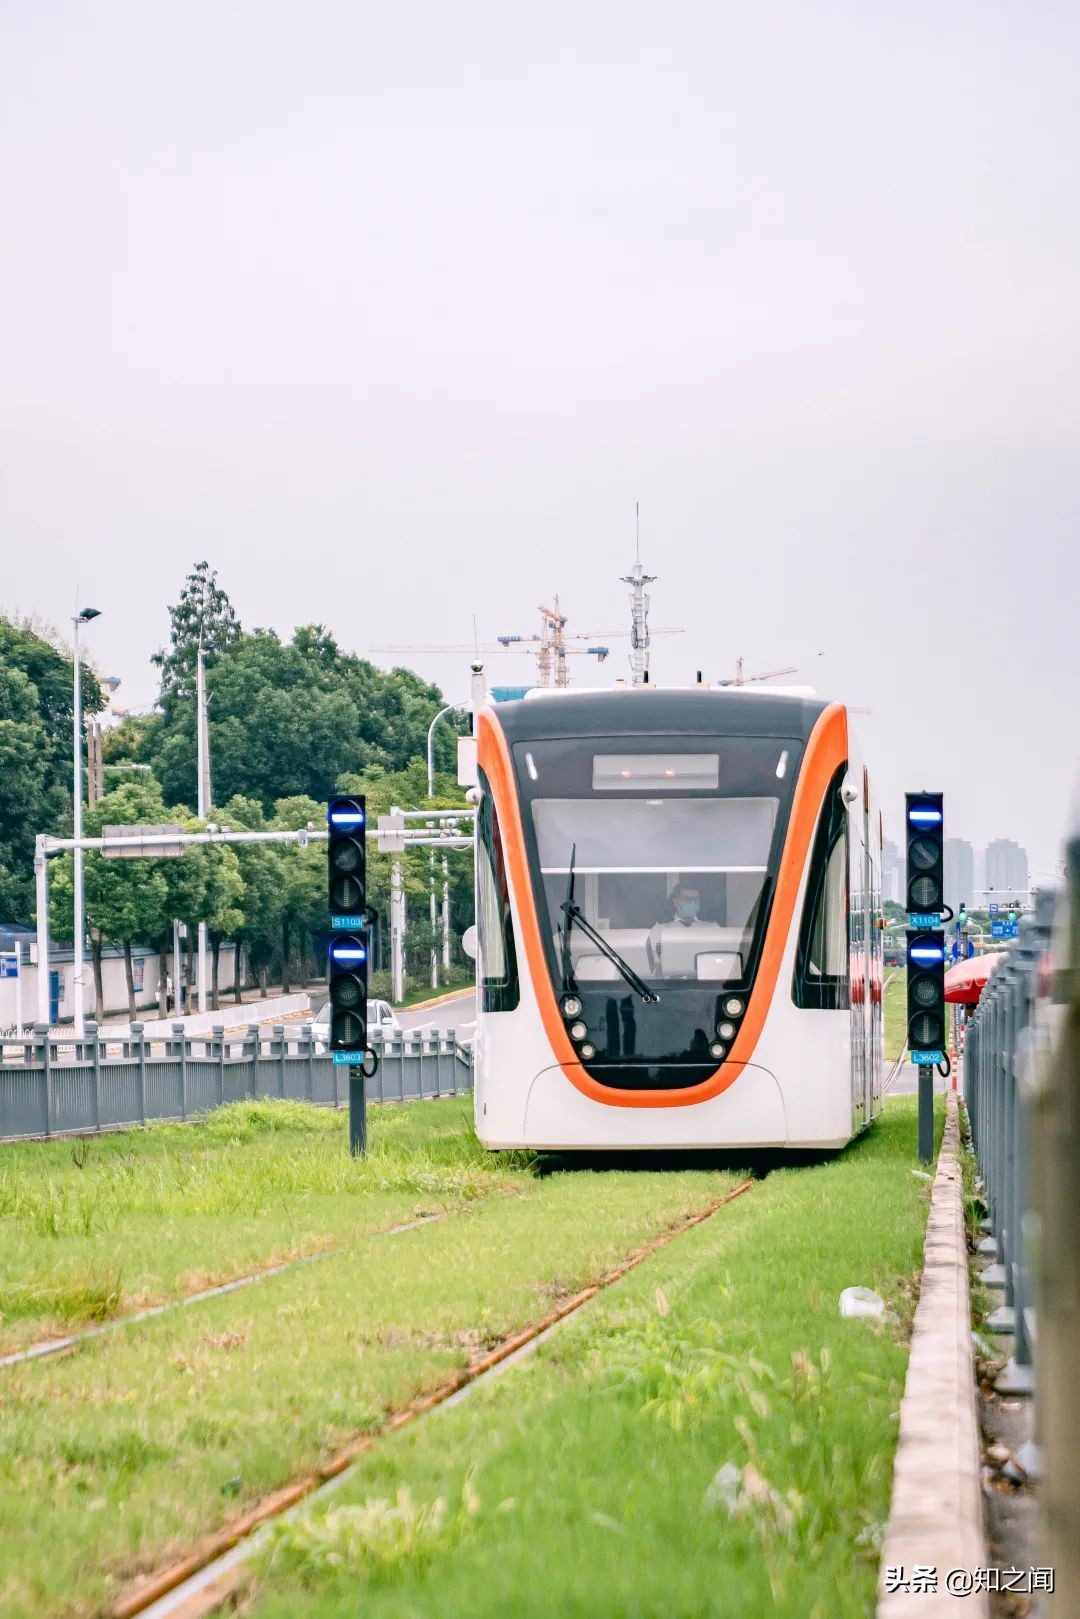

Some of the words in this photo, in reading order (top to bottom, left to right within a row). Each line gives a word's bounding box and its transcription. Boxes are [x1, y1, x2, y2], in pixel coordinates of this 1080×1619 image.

[334, 917, 361, 926] S1103
[911, 916, 938, 924] X1104
[335, 1053, 361, 1062] L3603
[913, 1053, 940, 1062] L3602
